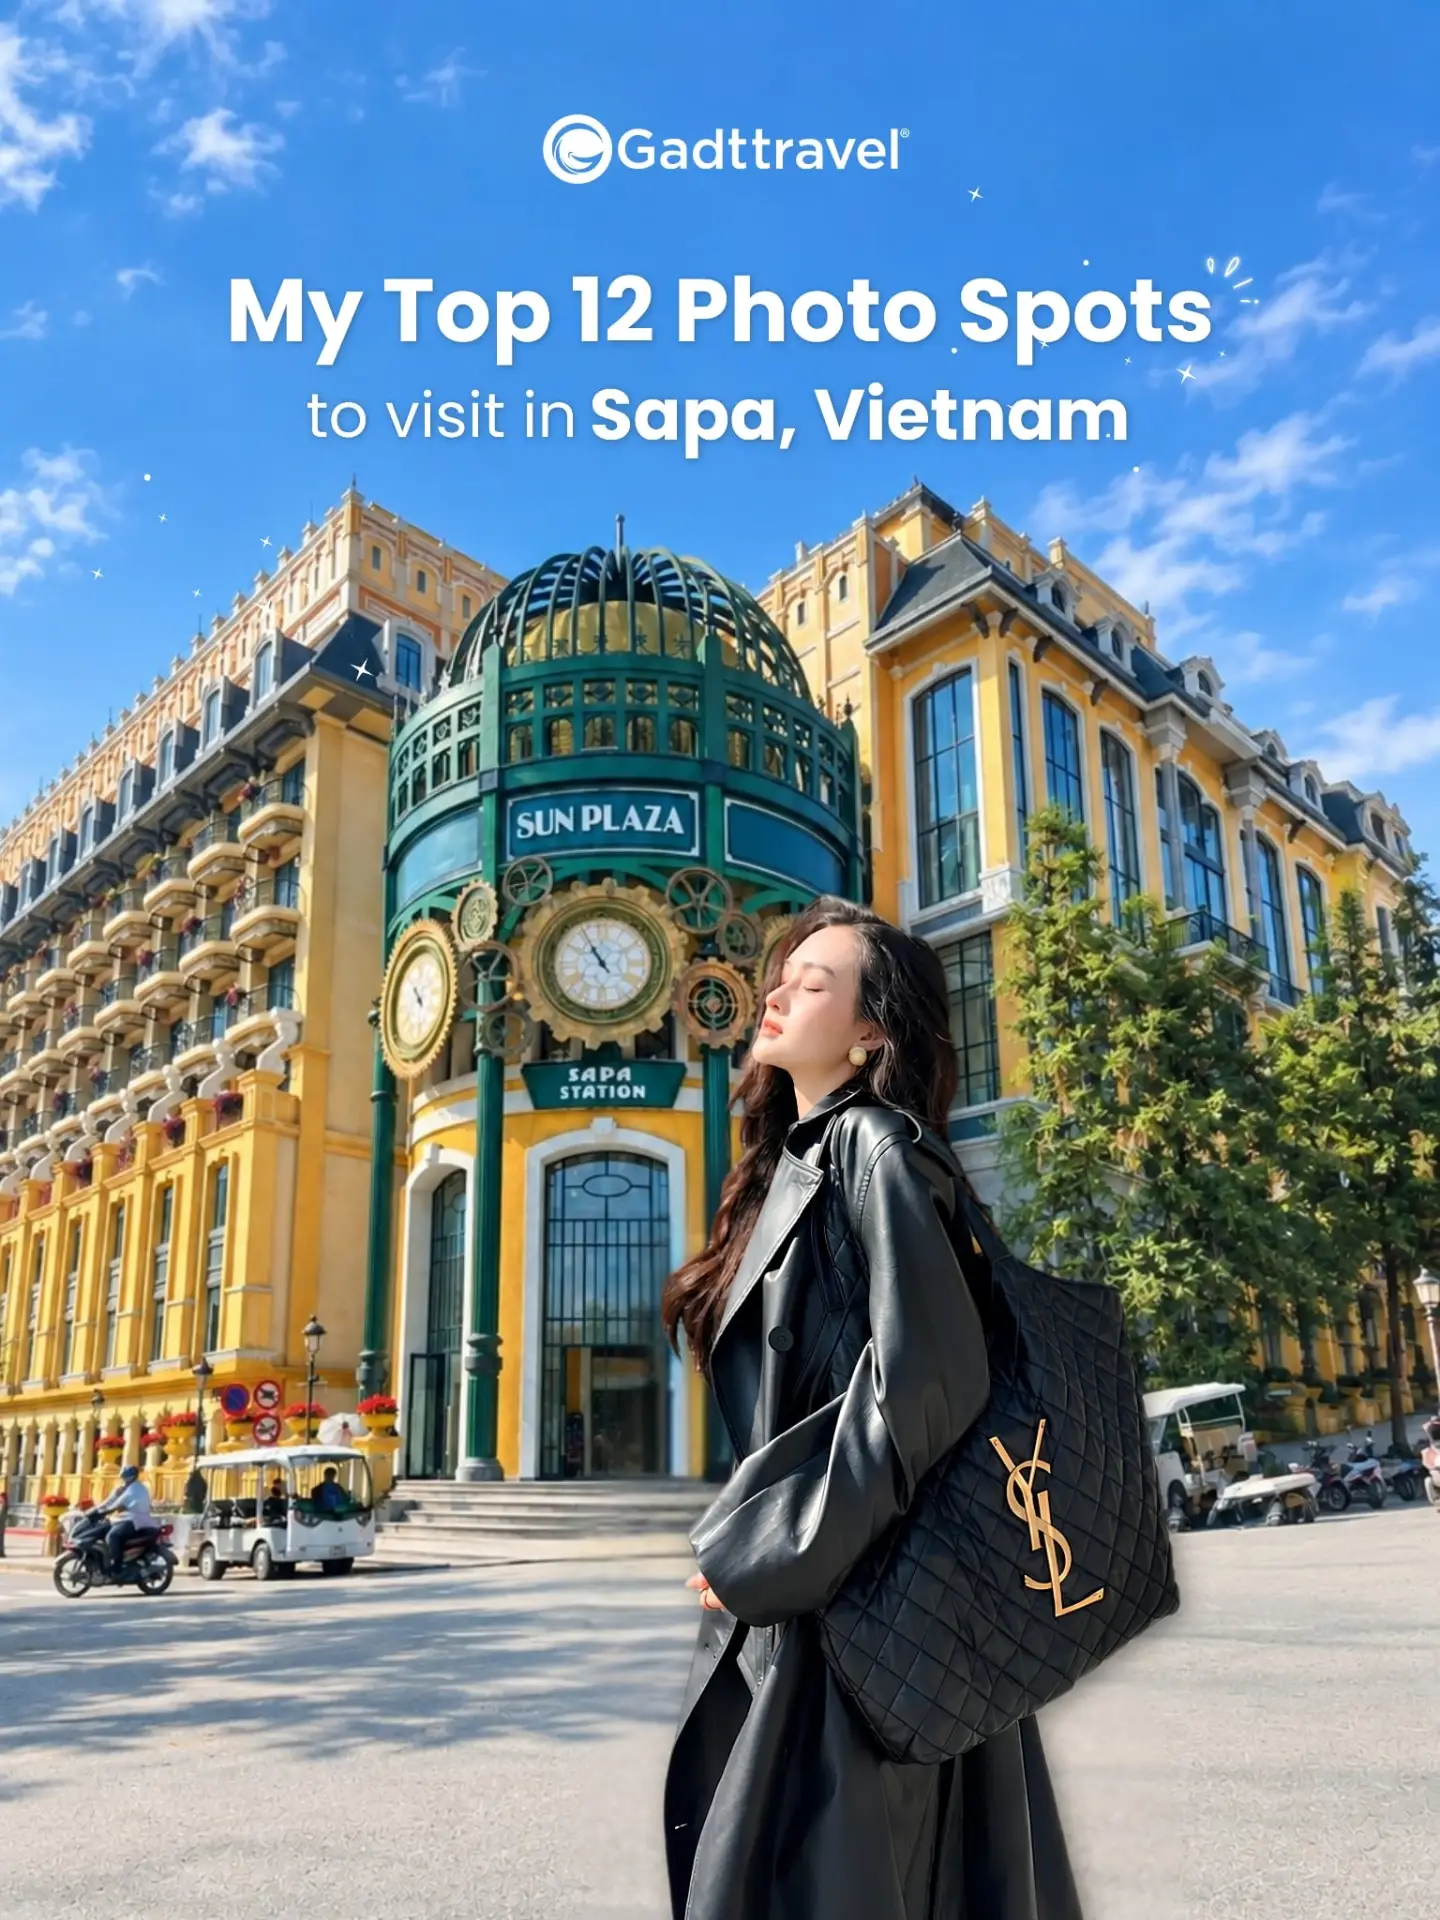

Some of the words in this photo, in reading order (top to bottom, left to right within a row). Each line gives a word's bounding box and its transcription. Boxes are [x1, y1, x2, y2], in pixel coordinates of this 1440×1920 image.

[516, 805, 574, 839] SUN
[581, 804, 685, 835] PLAZA
[568, 1066, 632, 1082] SAPA
[559, 1085, 646, 1100] STATION
[987, 1418, 1105, 1618] YSL
